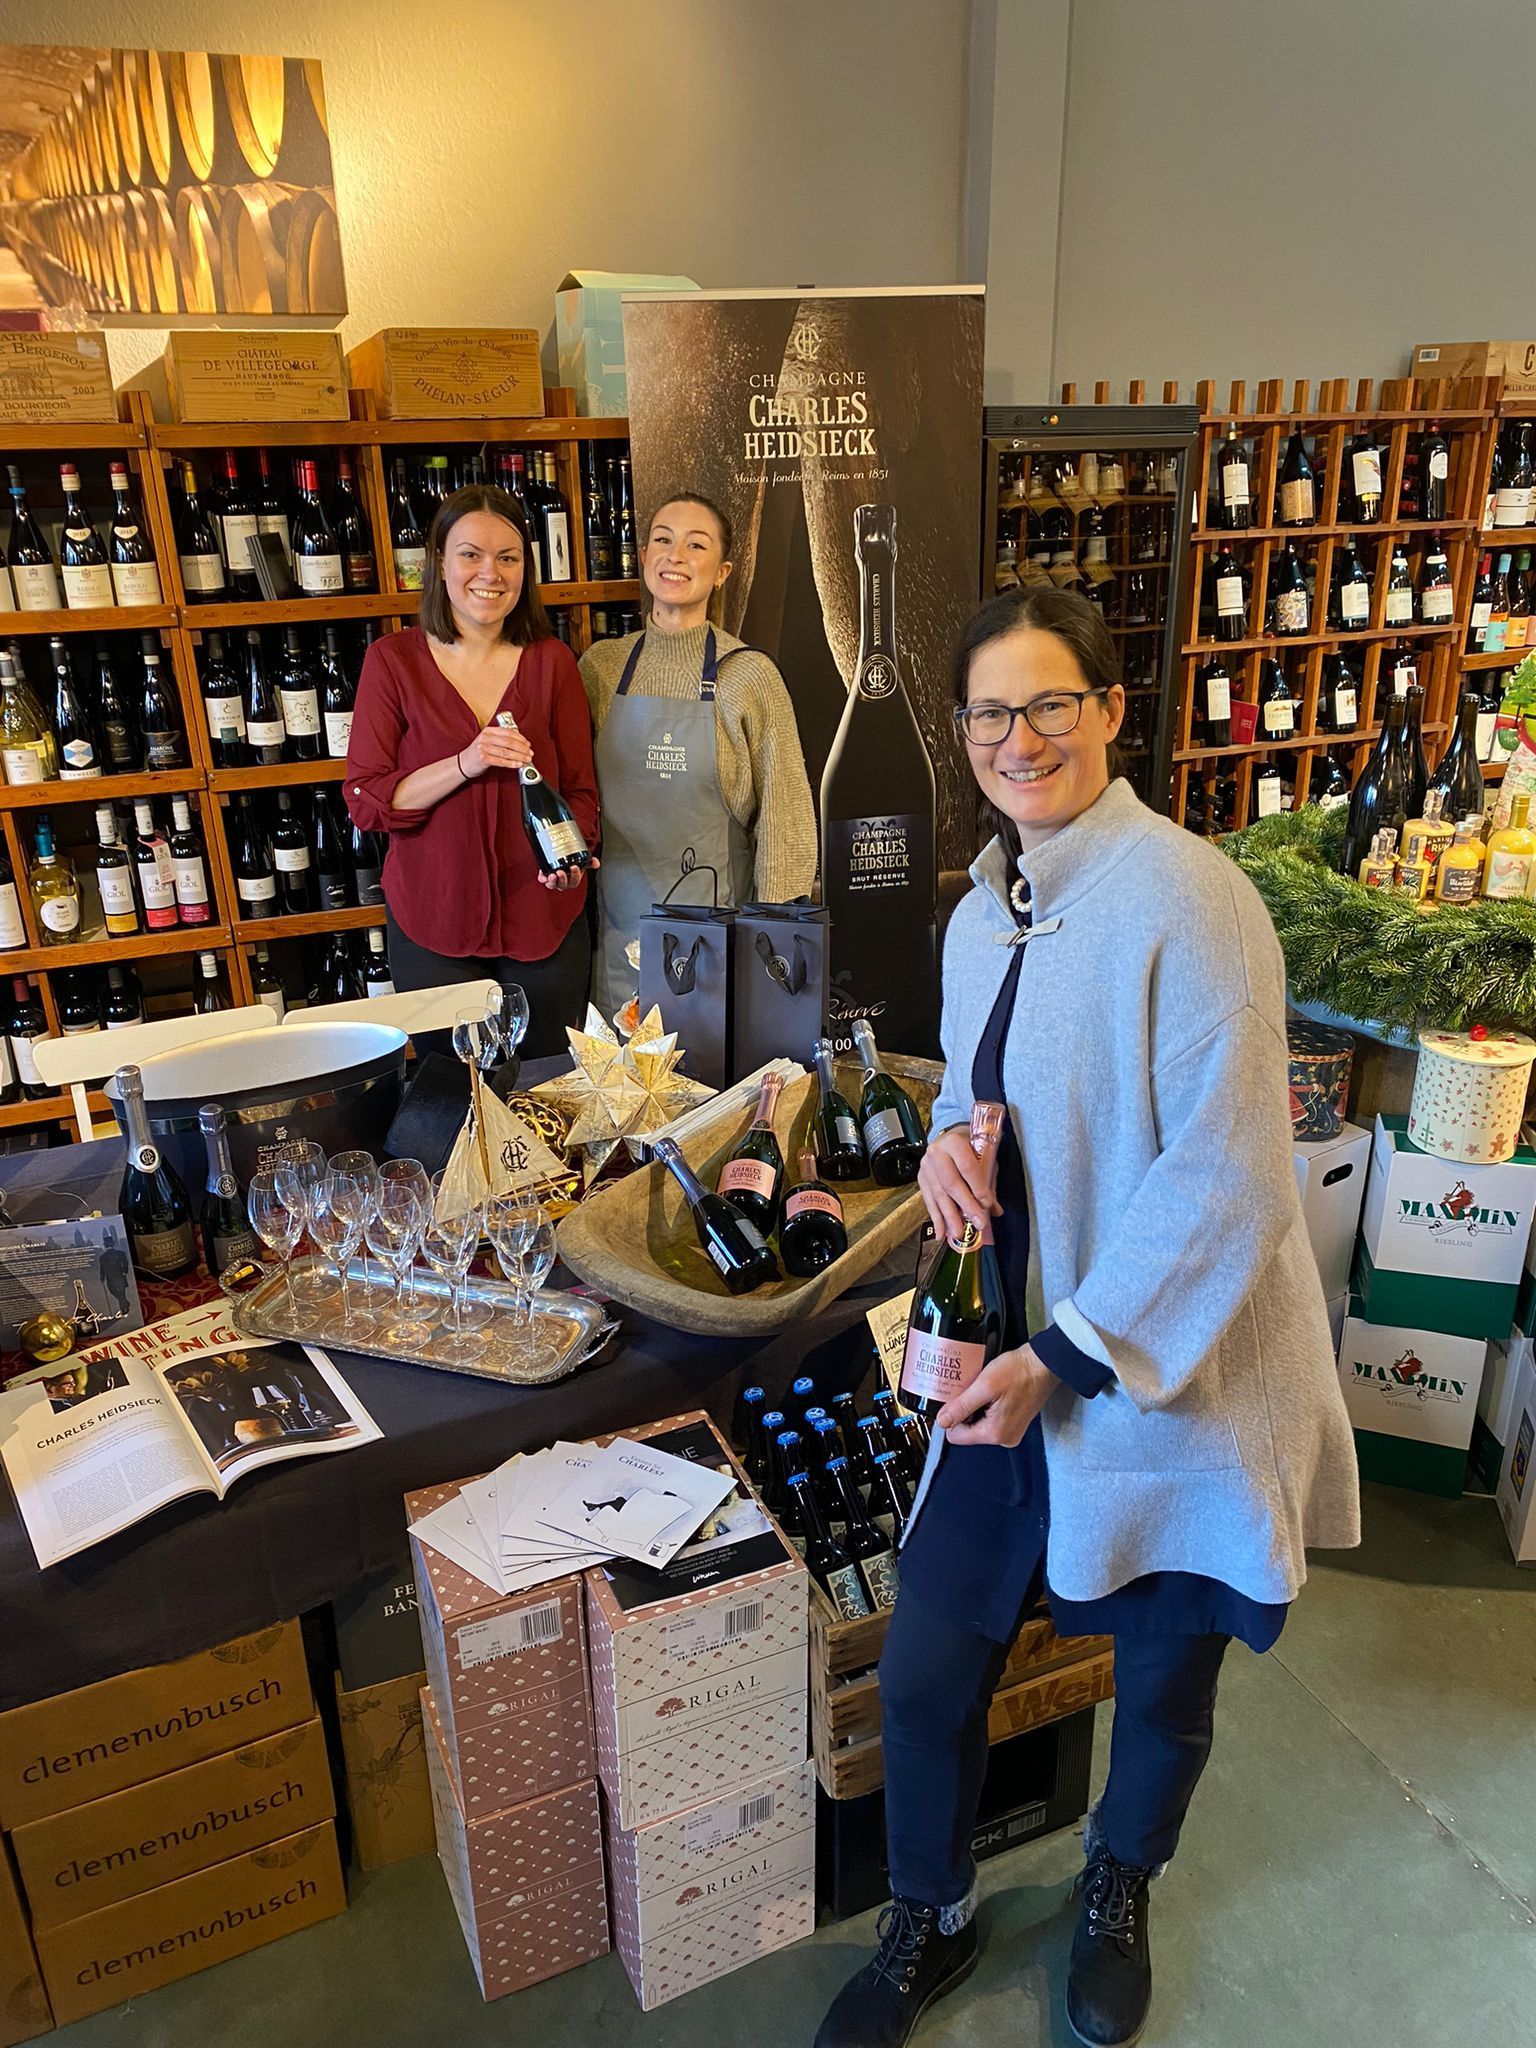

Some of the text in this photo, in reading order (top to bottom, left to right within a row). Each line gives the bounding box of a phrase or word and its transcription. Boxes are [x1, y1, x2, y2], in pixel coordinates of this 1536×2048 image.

[443, 338, 459, 347] Vin
[463, 336, 473, 345] du
[13, 341, 88, 371] BERGERON
[238, 347, 282, 359] CHÂTEAU
[203, 360, 319, 371] DE VILLEGEORGE
[749, 371, 867, 389] CHAMPAGNE
[72, 386, 96, 395] 2003
[5, 401, 71, 410] BOURGEOIS
[749, 391, 868, 428] CHARLES
[743, 428, 877, 460] HEIDSIECK
[732, 471, 770, 484] Maison
[772, 470, 804, 488] fondée
[820, 470, 850, 481] Reims
[853, 472, 865, 480] en
[868, 468, 889, 481] 1851
[871, 573, 883, 647] CHARLES HEIDSIECK
[645, 760, 688, 771] HEIDSIECK
[648, 750, 686, 762] CHARLES
[852, 828, 907, 840] CHAMPAGNE
[852, 838, 906, 857] CHARLES
[849, 854, 910, 871] HEIDSIECK
[873, 872, 906, 880] RÉSERVE
[732, 1166, 762, 1175] CHARLES
[1434, 1238, 1473, 1248] RIESLING
[77, 1322, 180, 1367] WINE
[919, 1349, 962, 1370] CHARLES
[915, 1360, 963, 1381] HEIDSIECK
[36, 1398, 163, 1449] CHARLES HEIDSIECK
[618, 1455, 665, 1477] CHARLES?
[510, 1688, 560, 1710] RIGAL
[689, 1675, 761, 1709] RIGAL
[706, 1859, 773, 1895] RIGAL
[526, 1878, 573, 1901] RIGAL
